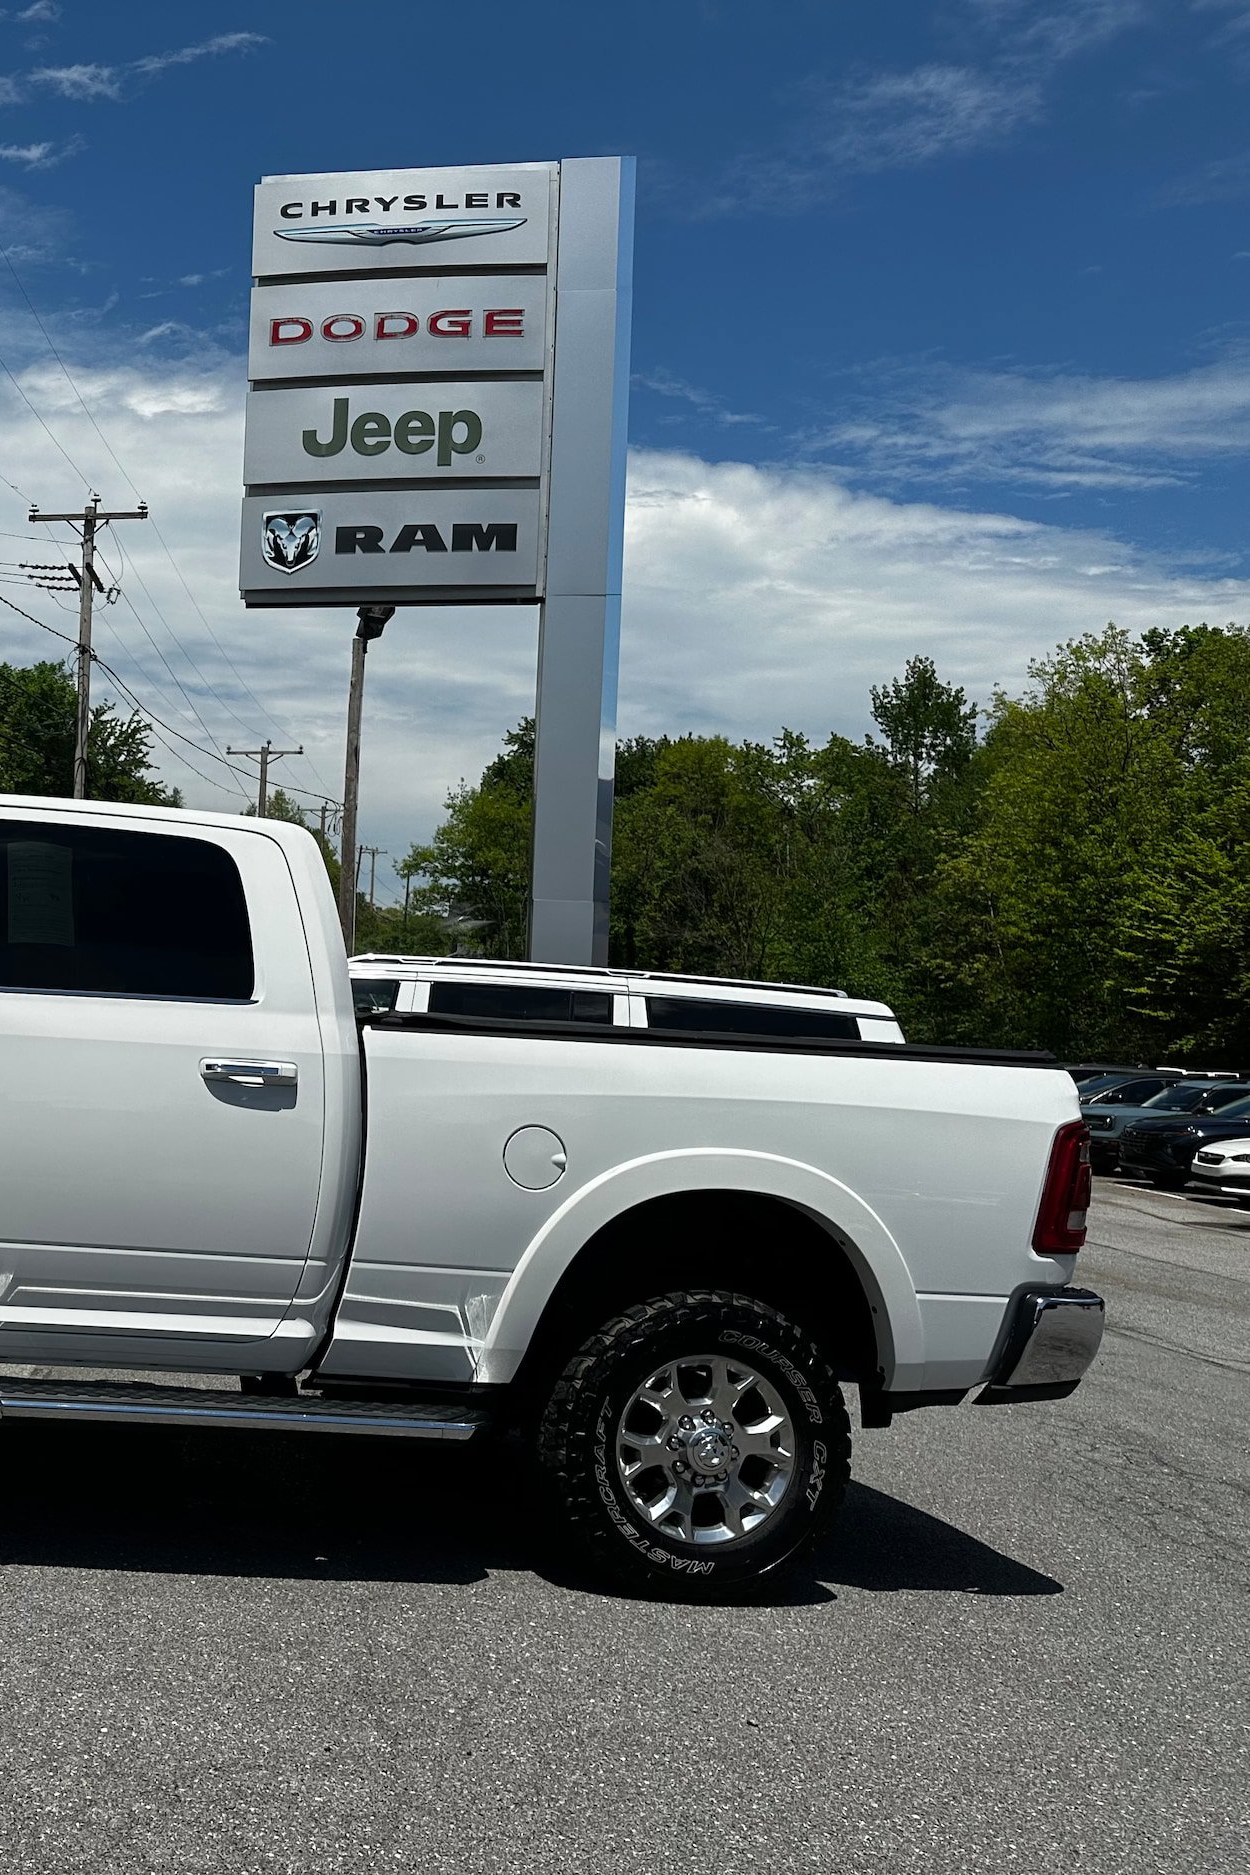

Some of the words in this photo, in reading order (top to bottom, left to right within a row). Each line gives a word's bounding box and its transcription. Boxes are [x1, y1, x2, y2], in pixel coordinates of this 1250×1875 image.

[279, 191, 523, 219] CHRYSLER
[269, 308, 525, 346] DODGE
[302, 397, 483, 467] Jeep
[335, 522, 518, 555] RAM
[718, 1329, 824, 1424] COURSER
[805, 1439, 828, 1512] CXT
[594, 1395, 716, 1575] MASTERCRAFT
